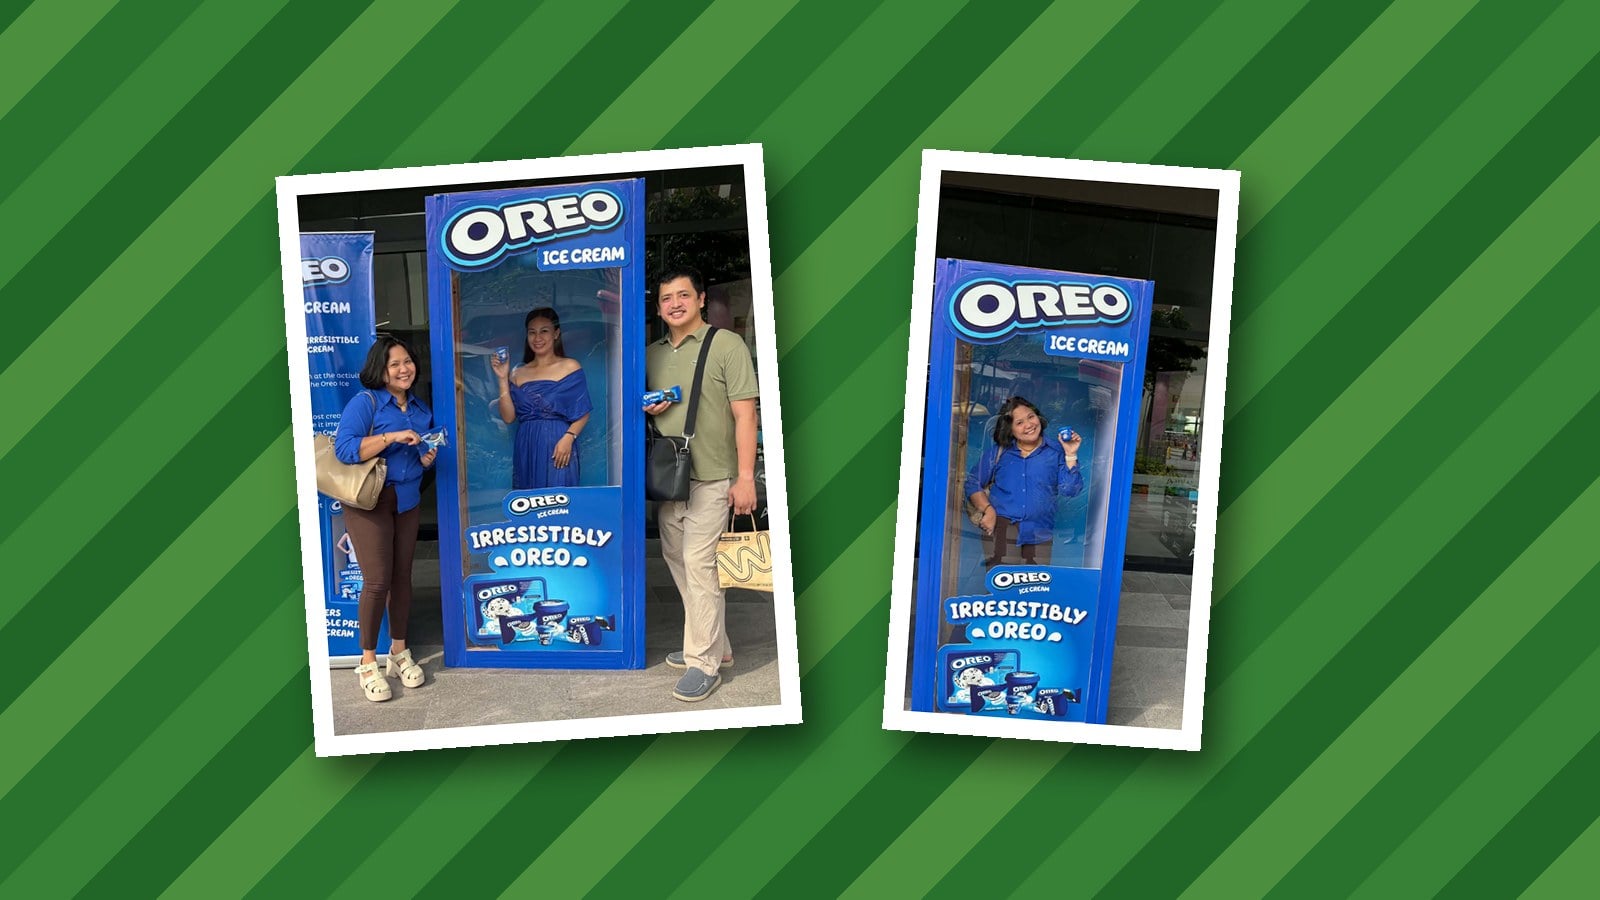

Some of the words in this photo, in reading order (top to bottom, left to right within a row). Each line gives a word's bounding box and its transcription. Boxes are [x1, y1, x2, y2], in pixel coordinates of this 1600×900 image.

[451, 192, 619, 255] OREO
[543, 249, 568, 266] ICE
[570, 246, 625, 263] CREAM
[304, 301, 351, 314] CREAM
[959, 283, 1128, 328] OREO
[307, 345, 335, 353] CREAM
[1050, 335, 1076, 352] ICE
[1077, 338, 1129, 357] CREAM
[510, 494, 568, 513] OREO
[537, 511, 547, 519] ICE
[548, 508, 569, 516] CREAM
[470, 525, 612, 549] IRRESISTIBLY
[510, 547, 571, 567] OREO
[994, 572, 1051, 587] OREO
[478, 584, 517, 600] OREO
[542, 613, 563, 622] OREO
[950, 600, 1088, 625] IRRESISTIBLY
[988, 621, 1047, 641] OREO
[951, 655, 992, 669] OREO
[1012, 684, 1033, 693] OREO
